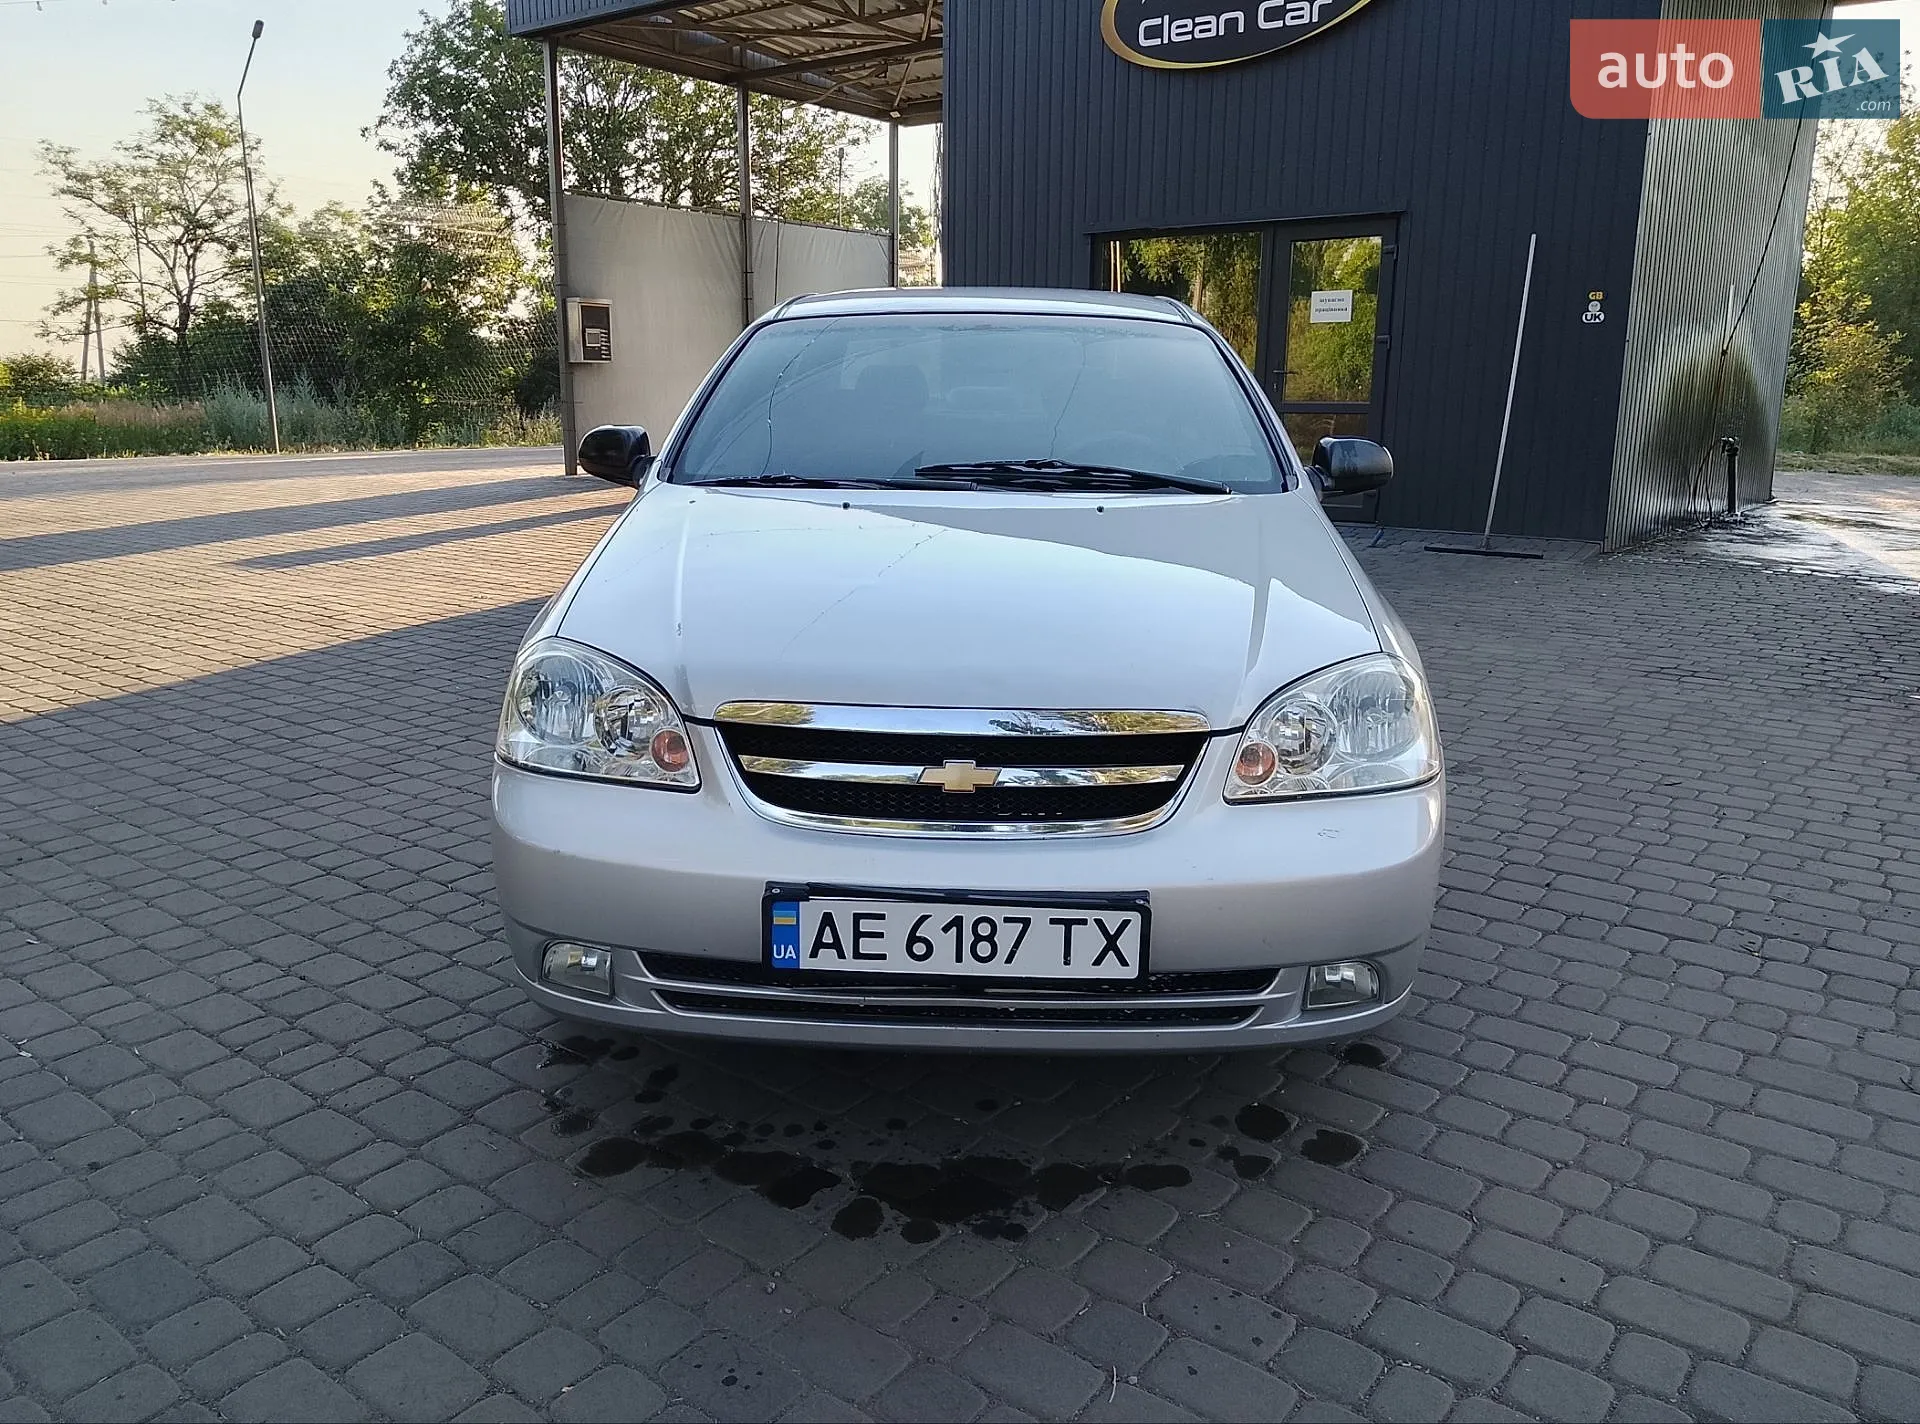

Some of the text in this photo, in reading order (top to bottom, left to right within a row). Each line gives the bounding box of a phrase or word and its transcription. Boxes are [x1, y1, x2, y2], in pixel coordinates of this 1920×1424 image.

[1138, 0, 1333, 47] Clean Car
[773, 944, 797, 960] UA
[808, 911, 1132, 968] AE 6187 TX
